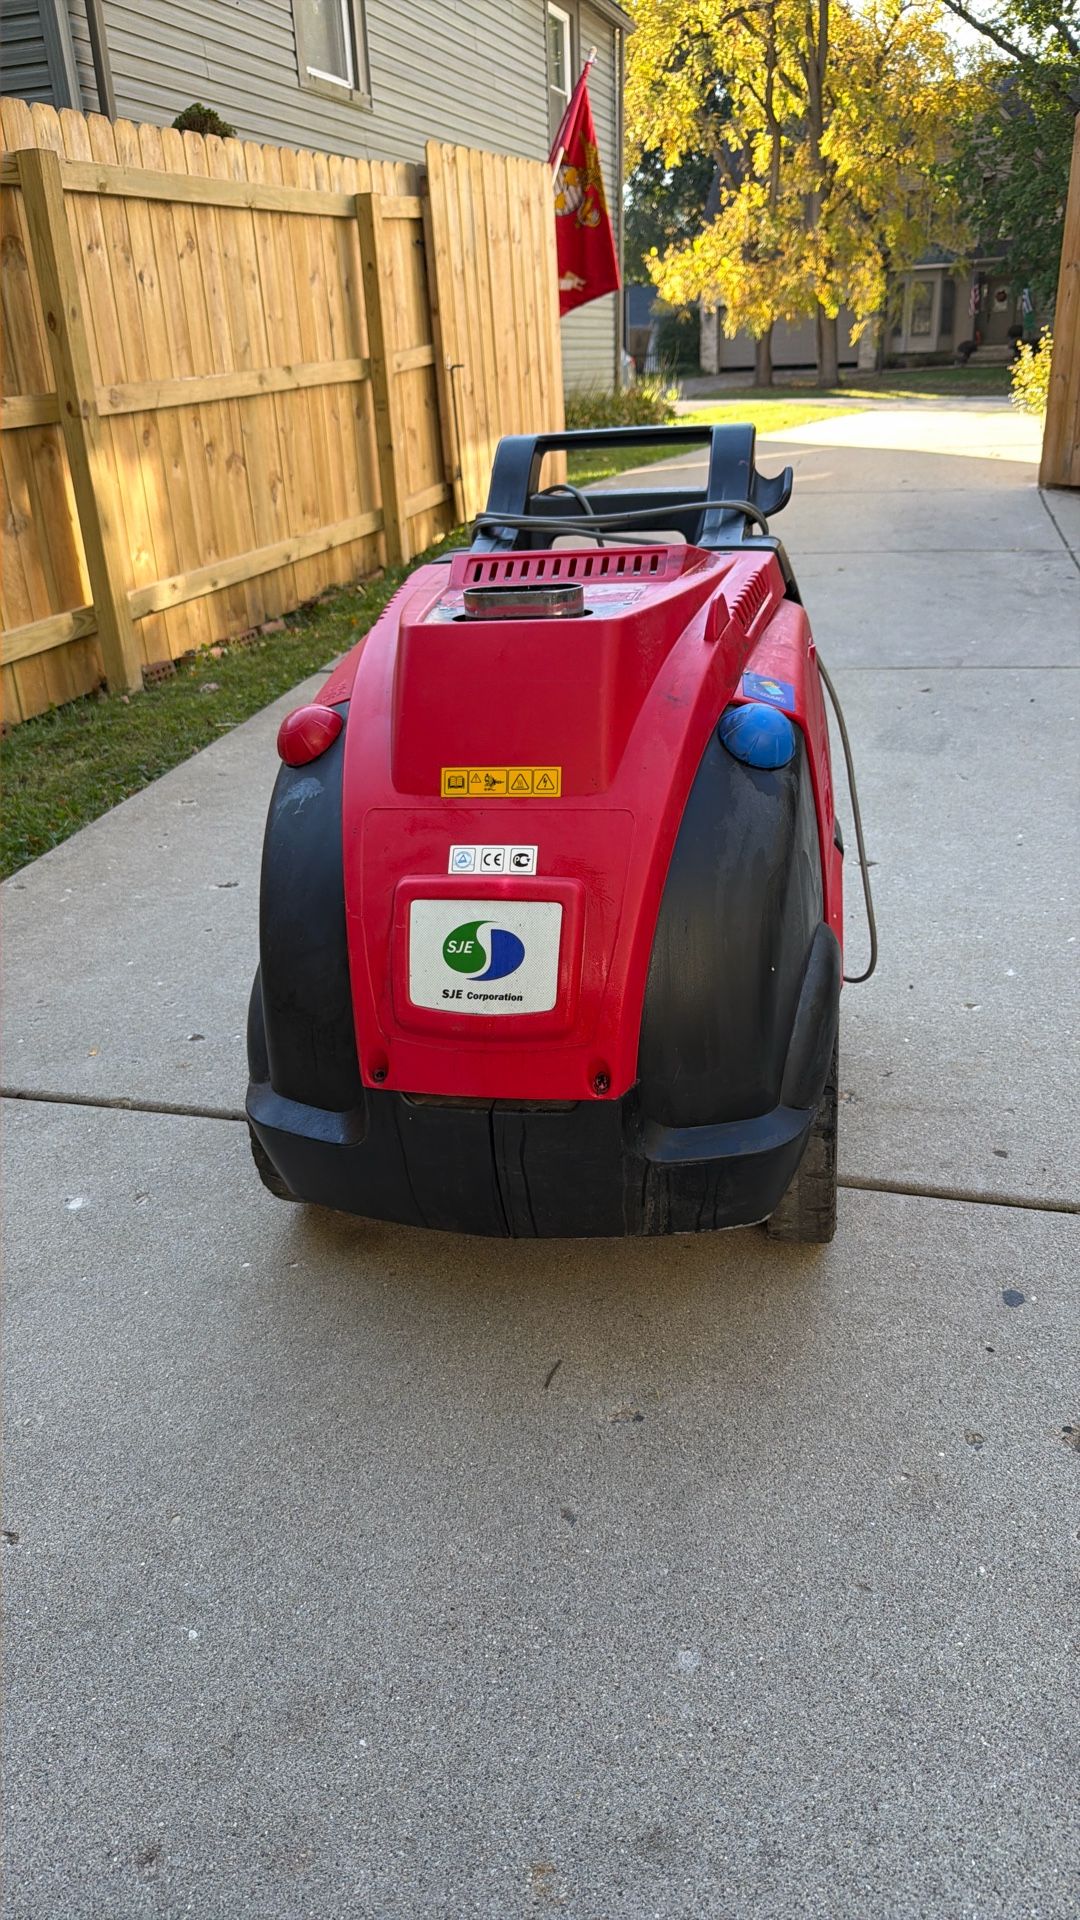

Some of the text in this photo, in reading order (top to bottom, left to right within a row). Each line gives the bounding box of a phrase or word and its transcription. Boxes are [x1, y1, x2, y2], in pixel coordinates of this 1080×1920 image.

[483, 853, 502, 867] CE
[446, 940, 475, 954] SJE
[442, 989, 523, 1001] SJE Corporation
